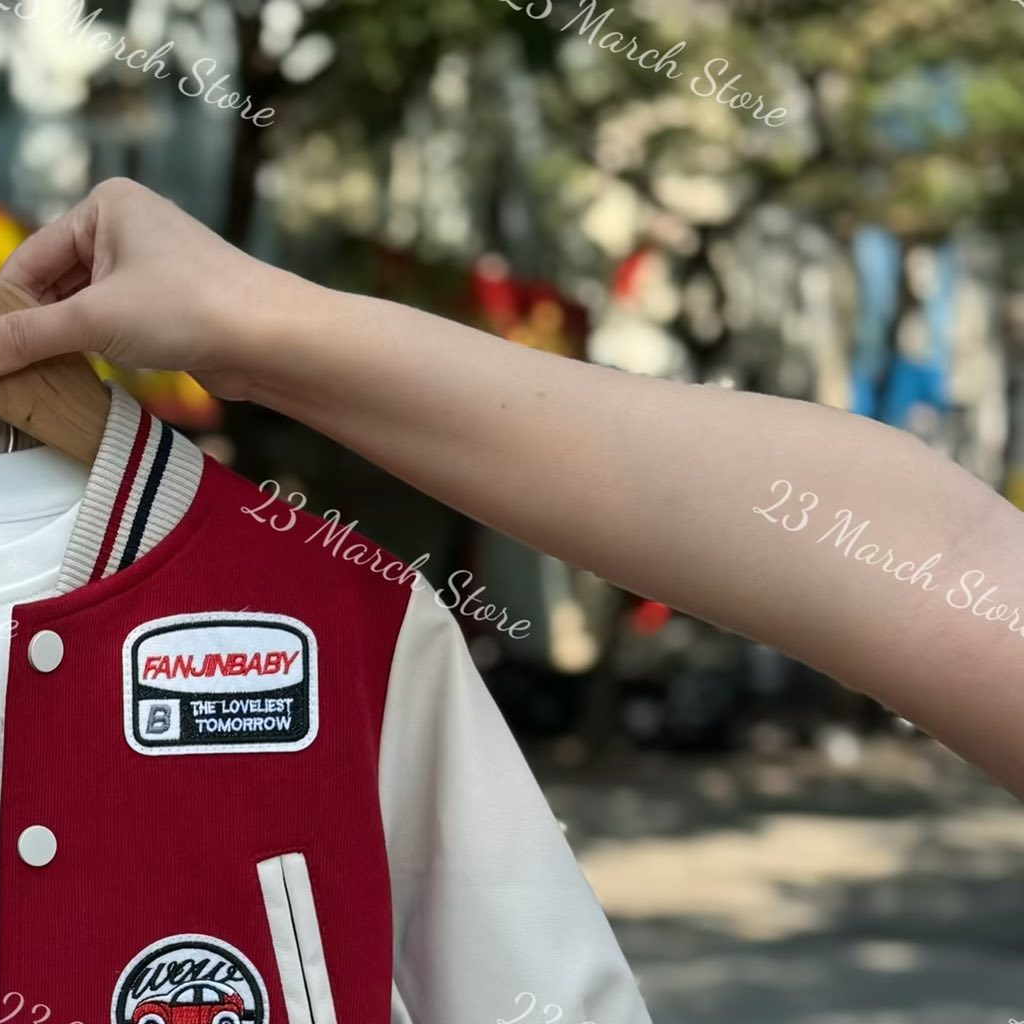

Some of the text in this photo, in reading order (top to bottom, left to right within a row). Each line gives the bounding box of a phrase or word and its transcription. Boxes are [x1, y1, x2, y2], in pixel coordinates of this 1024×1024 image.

[142, 650, 300, 680] FANJINBABY
[190, 697, 294, 715] THE LOVELIEST
[145, 703, 172, 734] B
[195, 716, 292, 733] TOMORROW
